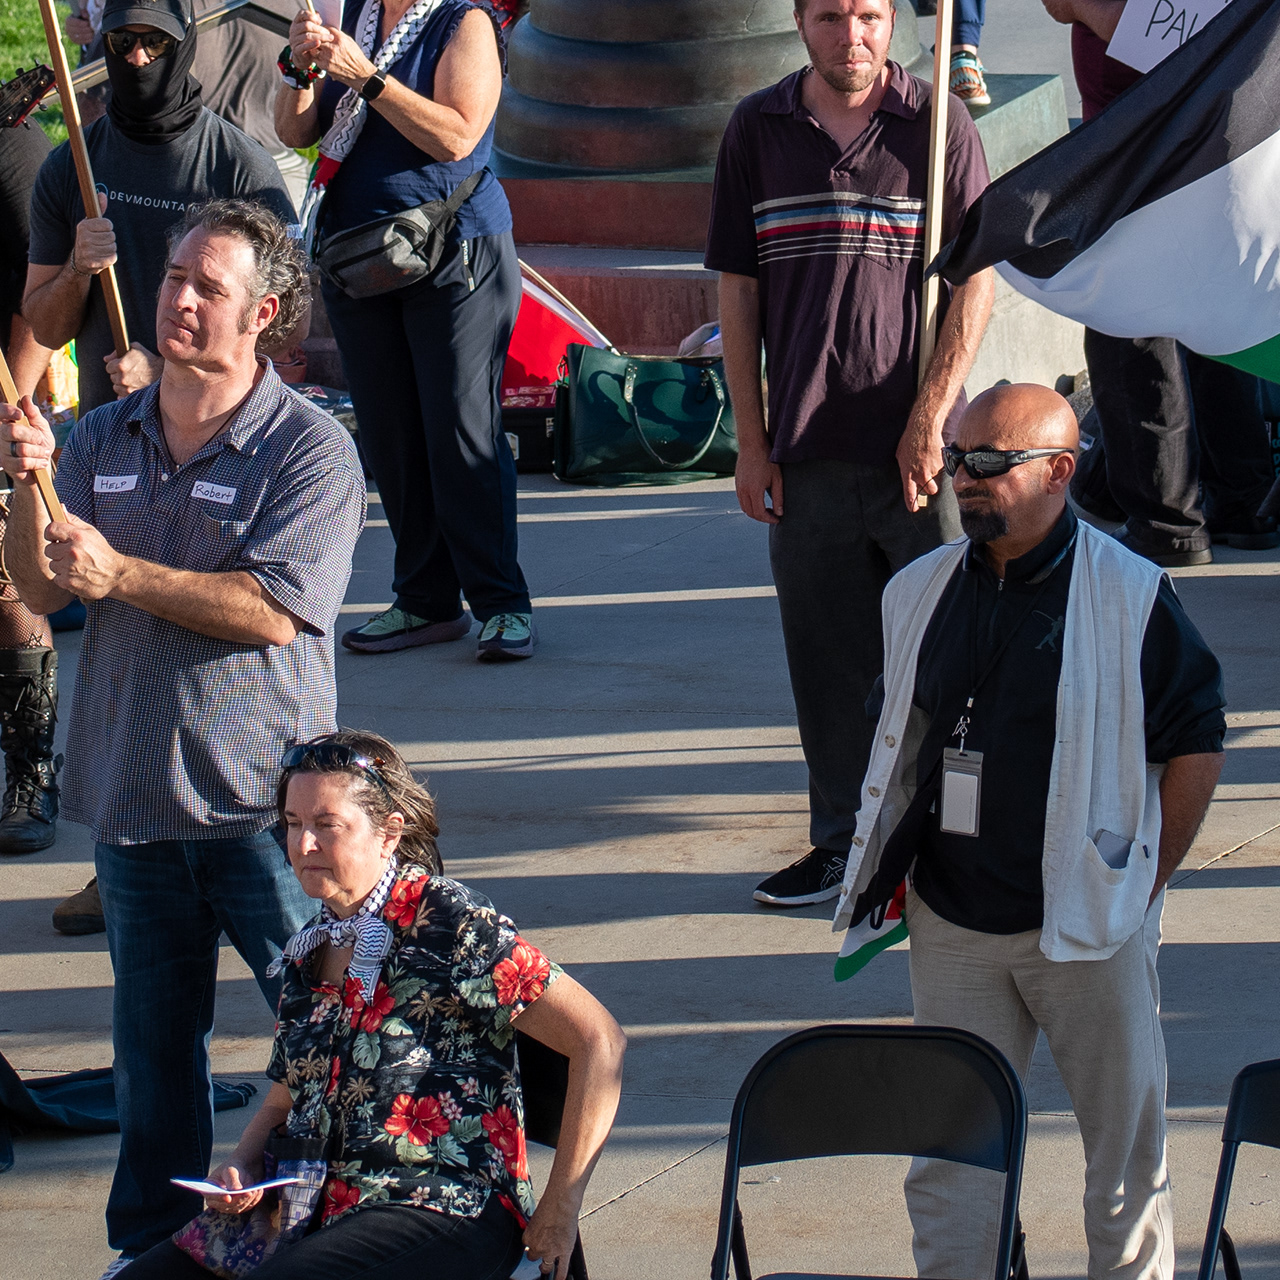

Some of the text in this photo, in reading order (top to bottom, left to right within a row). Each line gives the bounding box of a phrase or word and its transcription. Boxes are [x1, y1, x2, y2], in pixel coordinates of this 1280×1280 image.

[109, 190, 201, 213] DEVMOUNTAN
[100, 479, 127, 490] HELP
[194, 484, 233, 501] Robert
